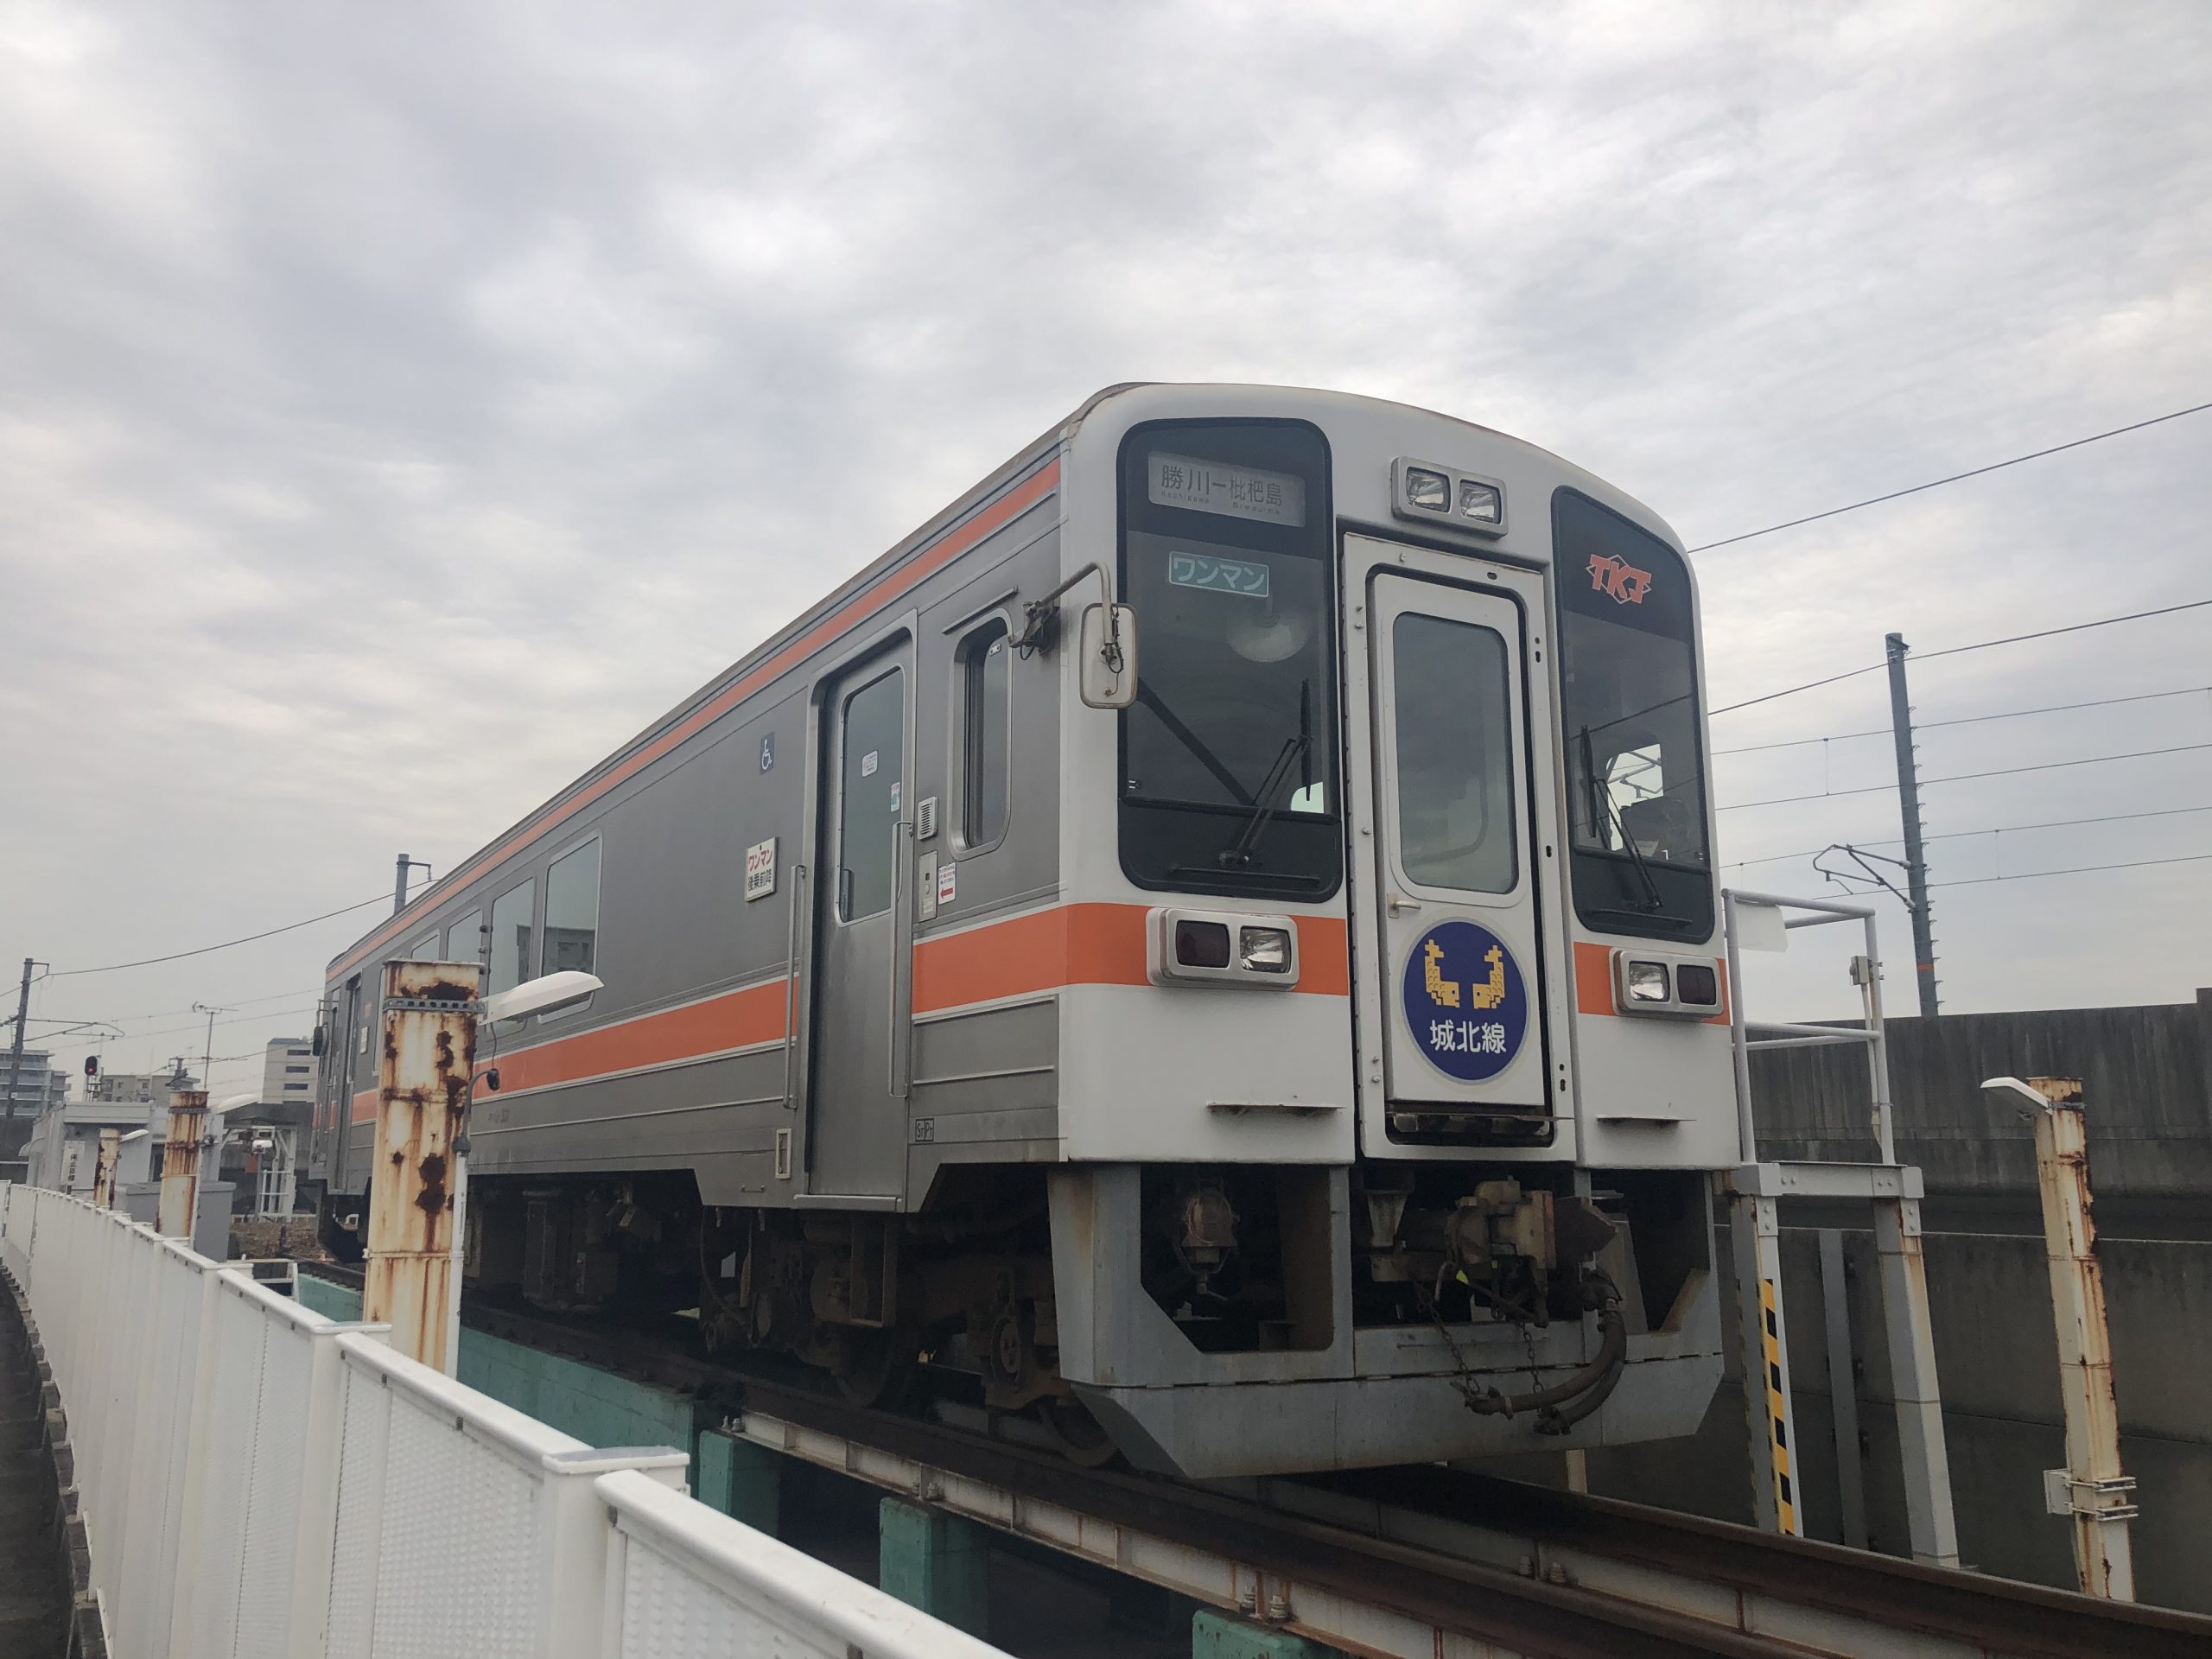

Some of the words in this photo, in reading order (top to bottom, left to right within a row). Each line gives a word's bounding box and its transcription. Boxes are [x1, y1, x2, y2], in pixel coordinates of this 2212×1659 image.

[1173, 557, 1264, 591] ワンマン
[1589, 554, 1651, 604] TKJ
[748, 849, 773, 872] ワンマン
[1430, 1019, 1506, 1054] 城北線
